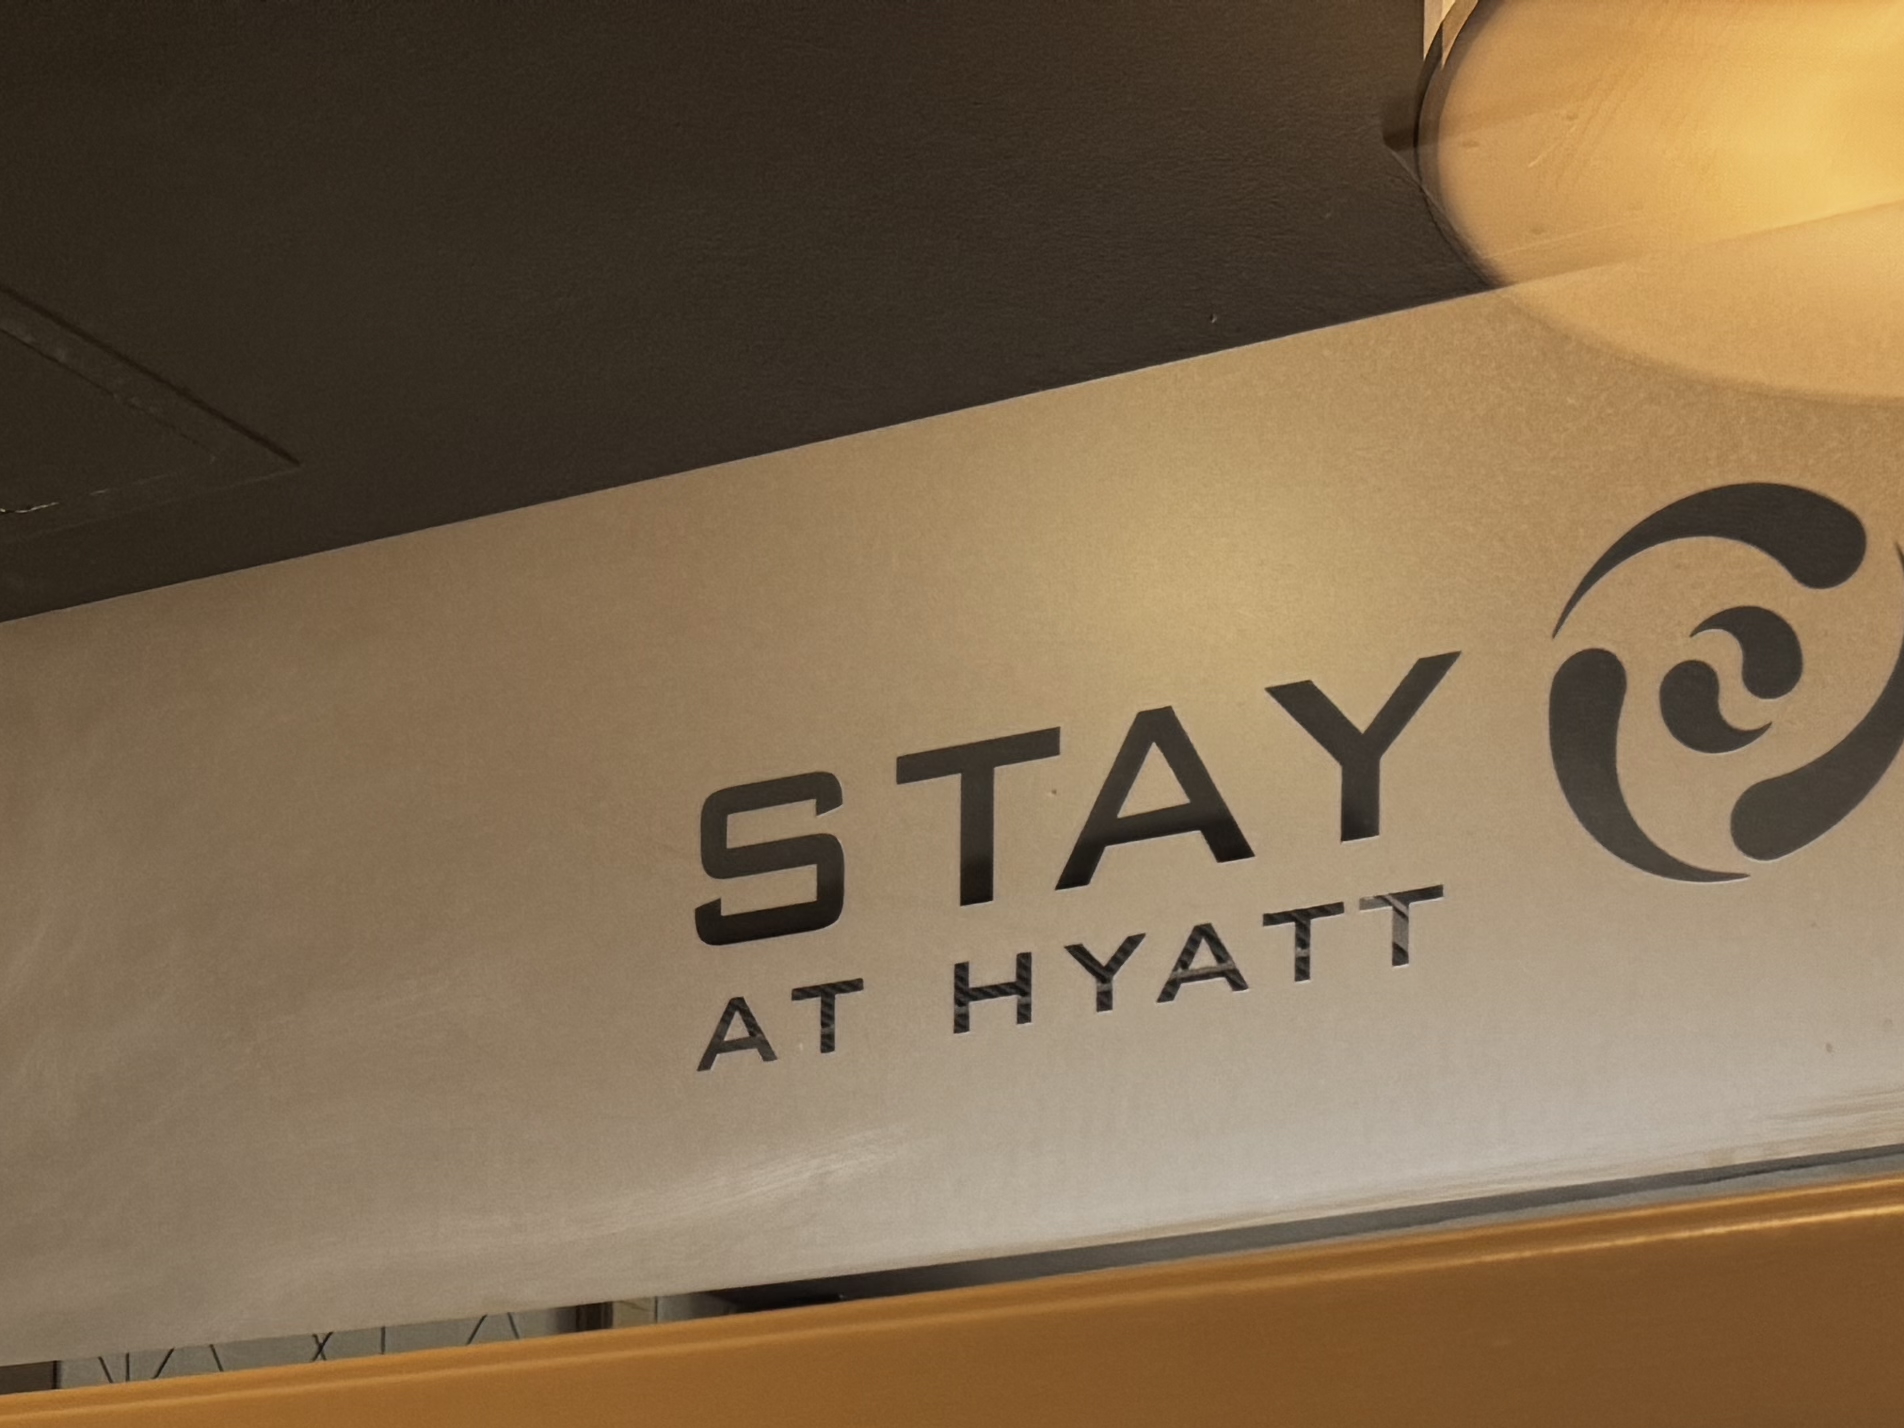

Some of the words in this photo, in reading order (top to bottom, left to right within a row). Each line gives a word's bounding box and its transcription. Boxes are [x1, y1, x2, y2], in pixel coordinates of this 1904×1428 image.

[694, 652, 1462, 947] STAY
[696, 977, 864, 1072] AT
[953, 884, 1445, 1034] HYATT
